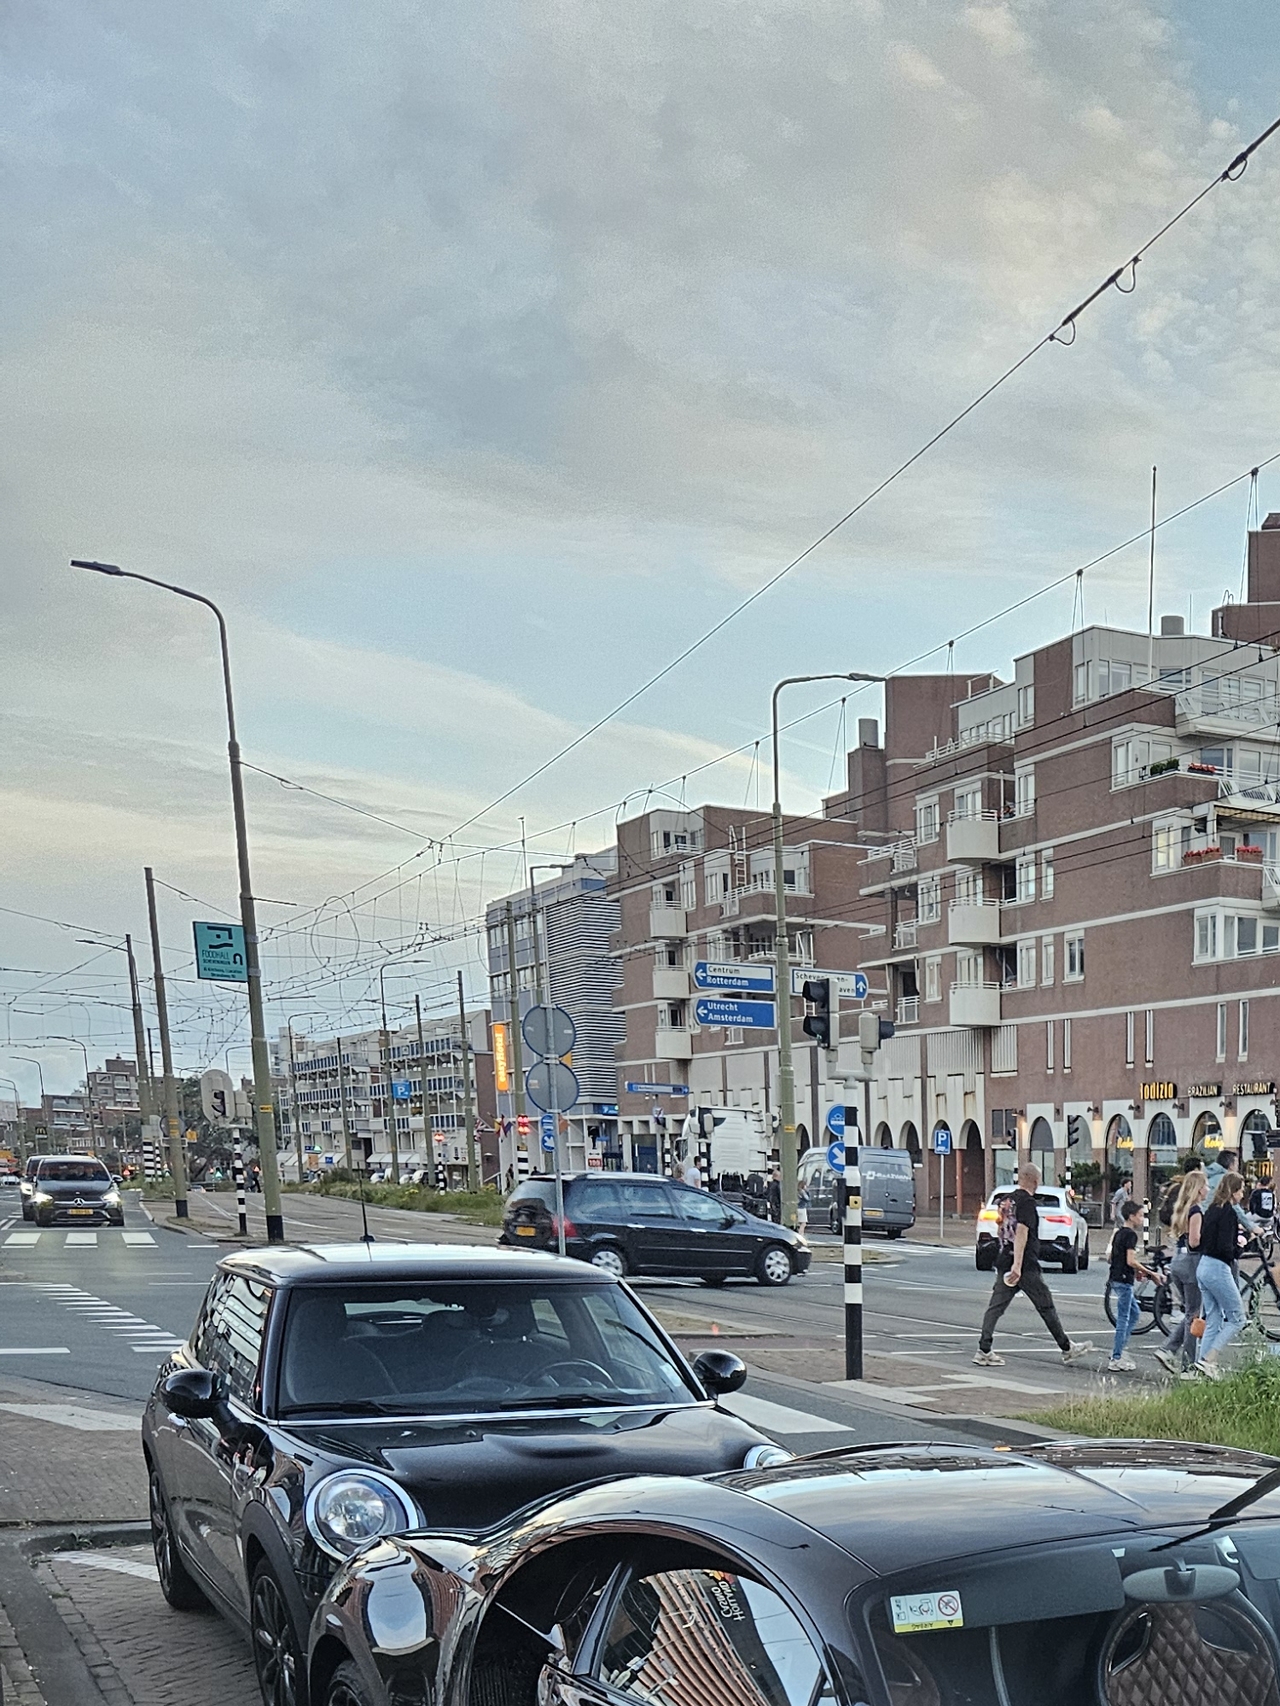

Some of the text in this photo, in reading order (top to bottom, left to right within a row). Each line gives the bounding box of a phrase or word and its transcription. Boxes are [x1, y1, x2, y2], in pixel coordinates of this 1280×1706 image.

[708, 966, 741, 975] Centrum
[707, 976, 749, 986] Rotterdam
[707, 1002, 738, 1012] Utrecht
[707, 1013, 754, 1023] Amsterdam
[495, 1032, 506, 1082] easyHotel
[1187, 1085, 1218, 1097] BRAZILIAN
[1232, 1082, 1272, 1095] RESTAURANT
[911, 1622, 933, 1630] AIRBAG
